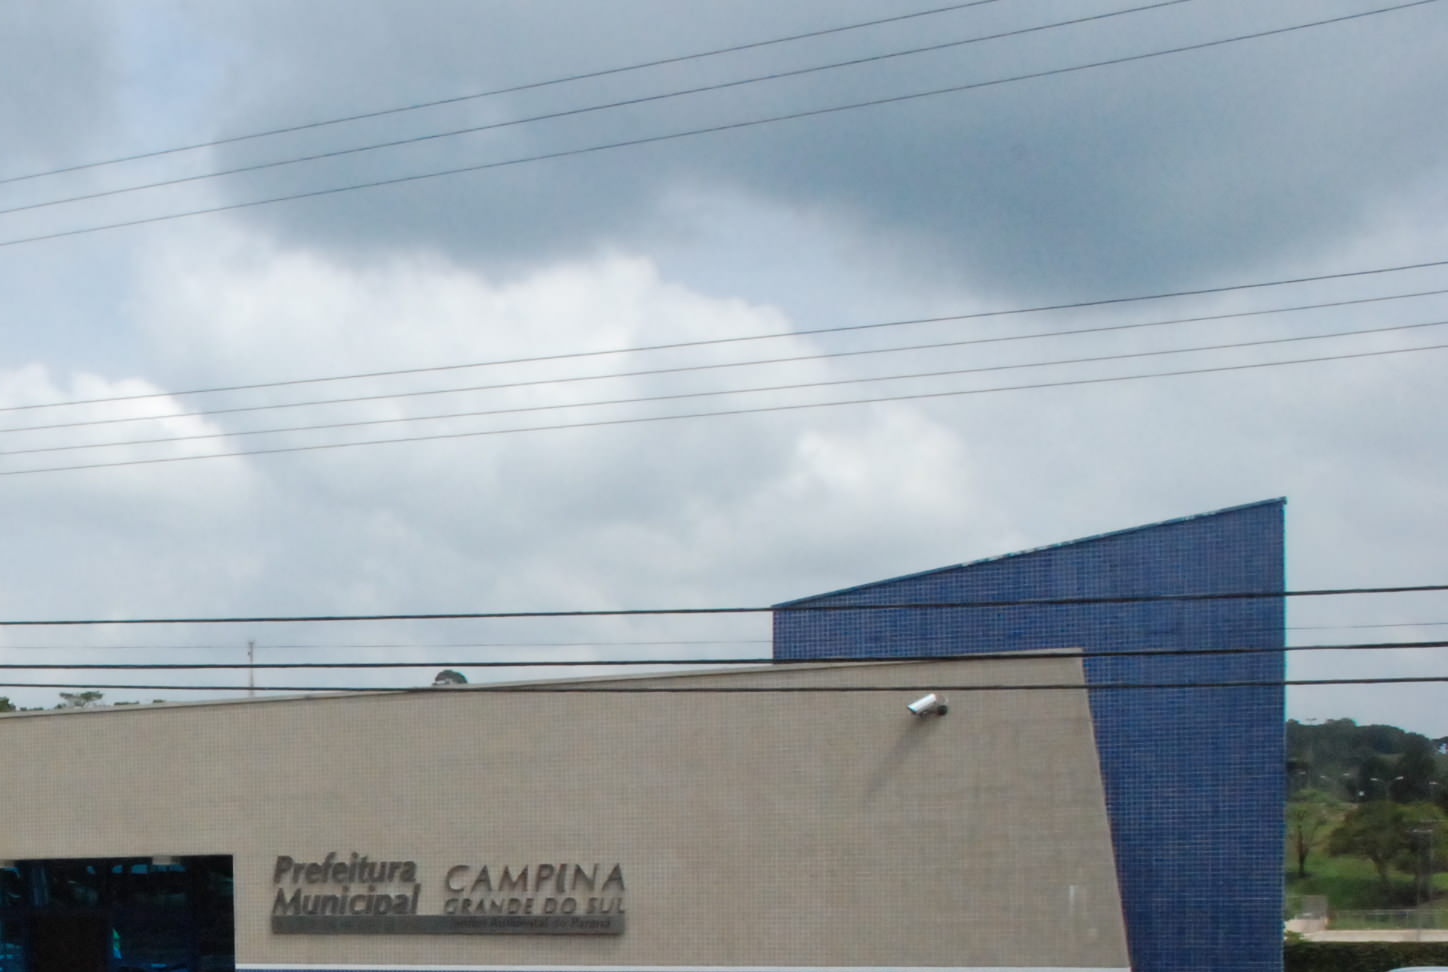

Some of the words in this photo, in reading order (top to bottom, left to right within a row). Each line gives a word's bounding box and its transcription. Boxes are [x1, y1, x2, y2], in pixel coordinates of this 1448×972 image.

[273, 852, 417, 884] Prefeitura
[446, 863, 625, 893] CAMPINA
[272, 883, 421, 915] Municipal
[443, 898, 534, 914] GRANDE
[543, 898, 577, 914] DO
[585, 897, 625, 914] SUL
